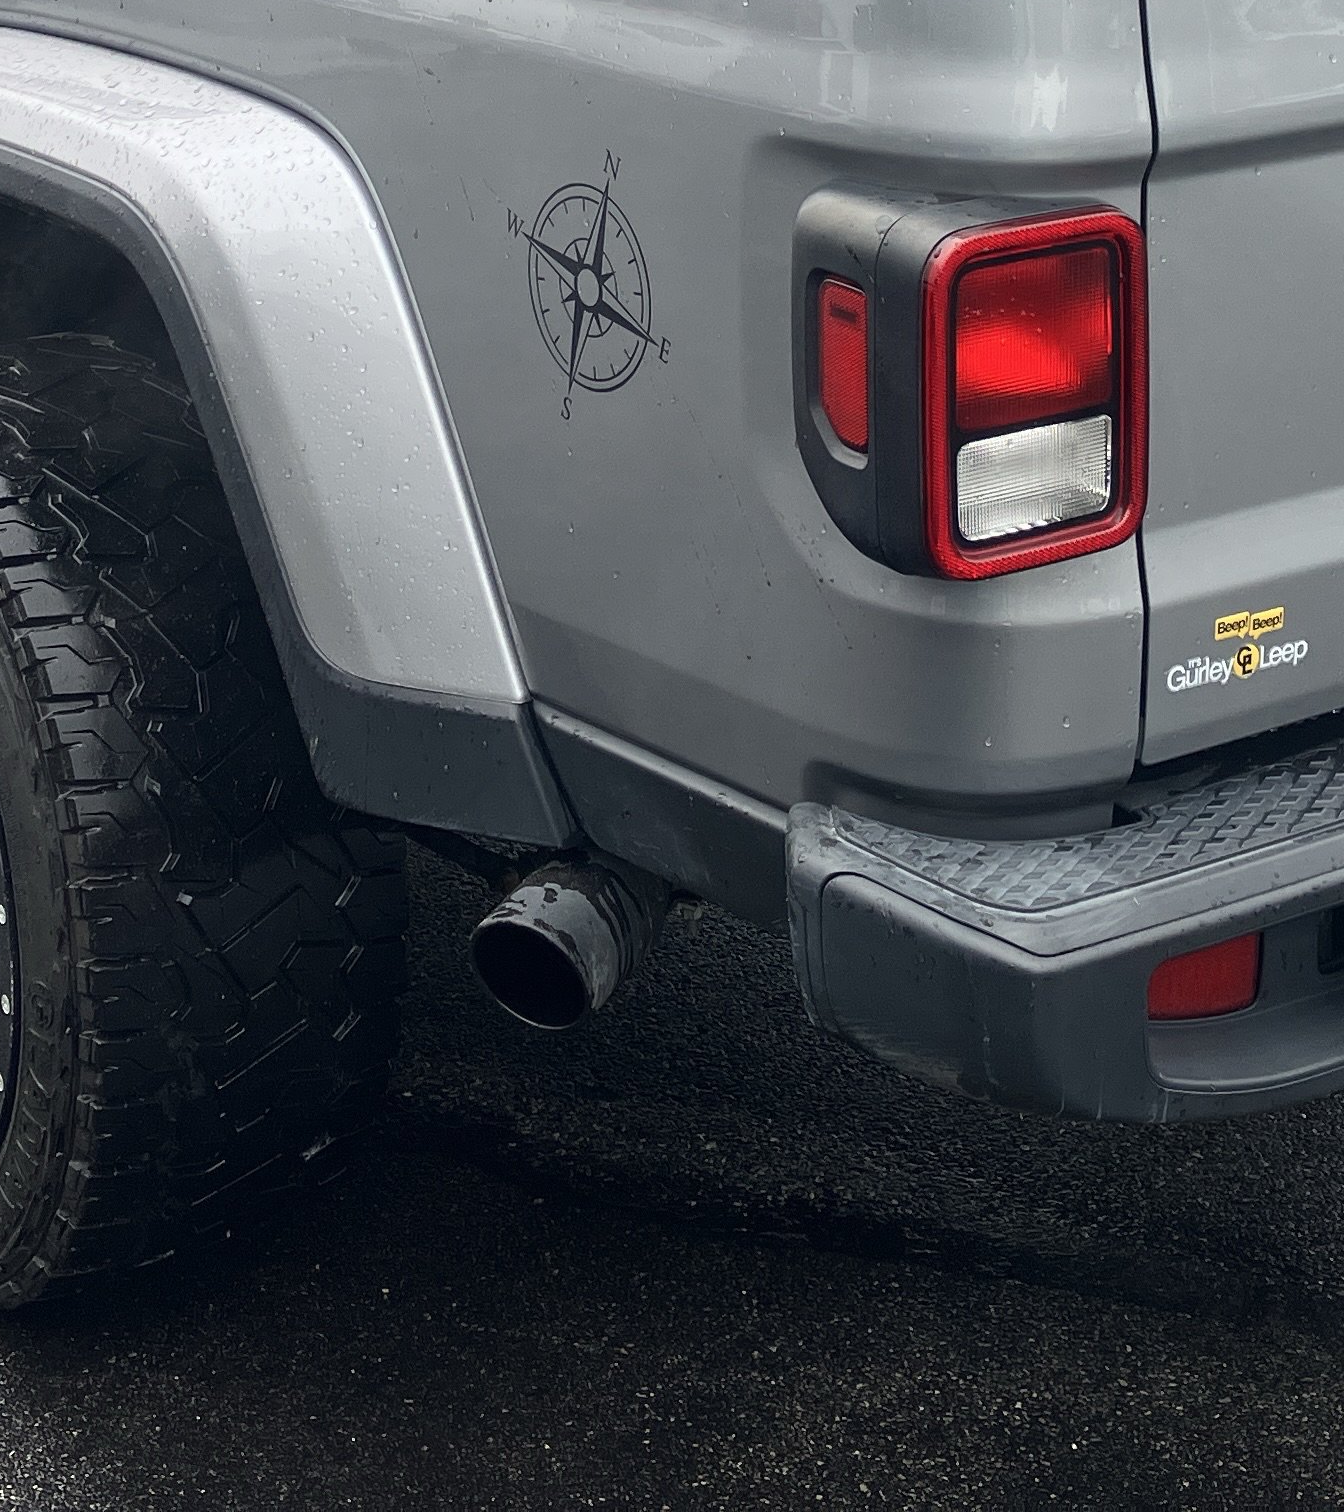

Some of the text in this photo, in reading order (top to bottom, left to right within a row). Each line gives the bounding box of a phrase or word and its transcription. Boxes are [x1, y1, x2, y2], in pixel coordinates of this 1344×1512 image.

[603, 148, 622, 181] N
[506, 207, 525, 239] W
[659, 336, 672, 364] E
[560, 396, 573, 420] S
[1217, 612, 1284, 635] Beep! Beep!
[1167, 656, 1234, 692] Gurley
[1260, 640, 1309, 668] Leep
